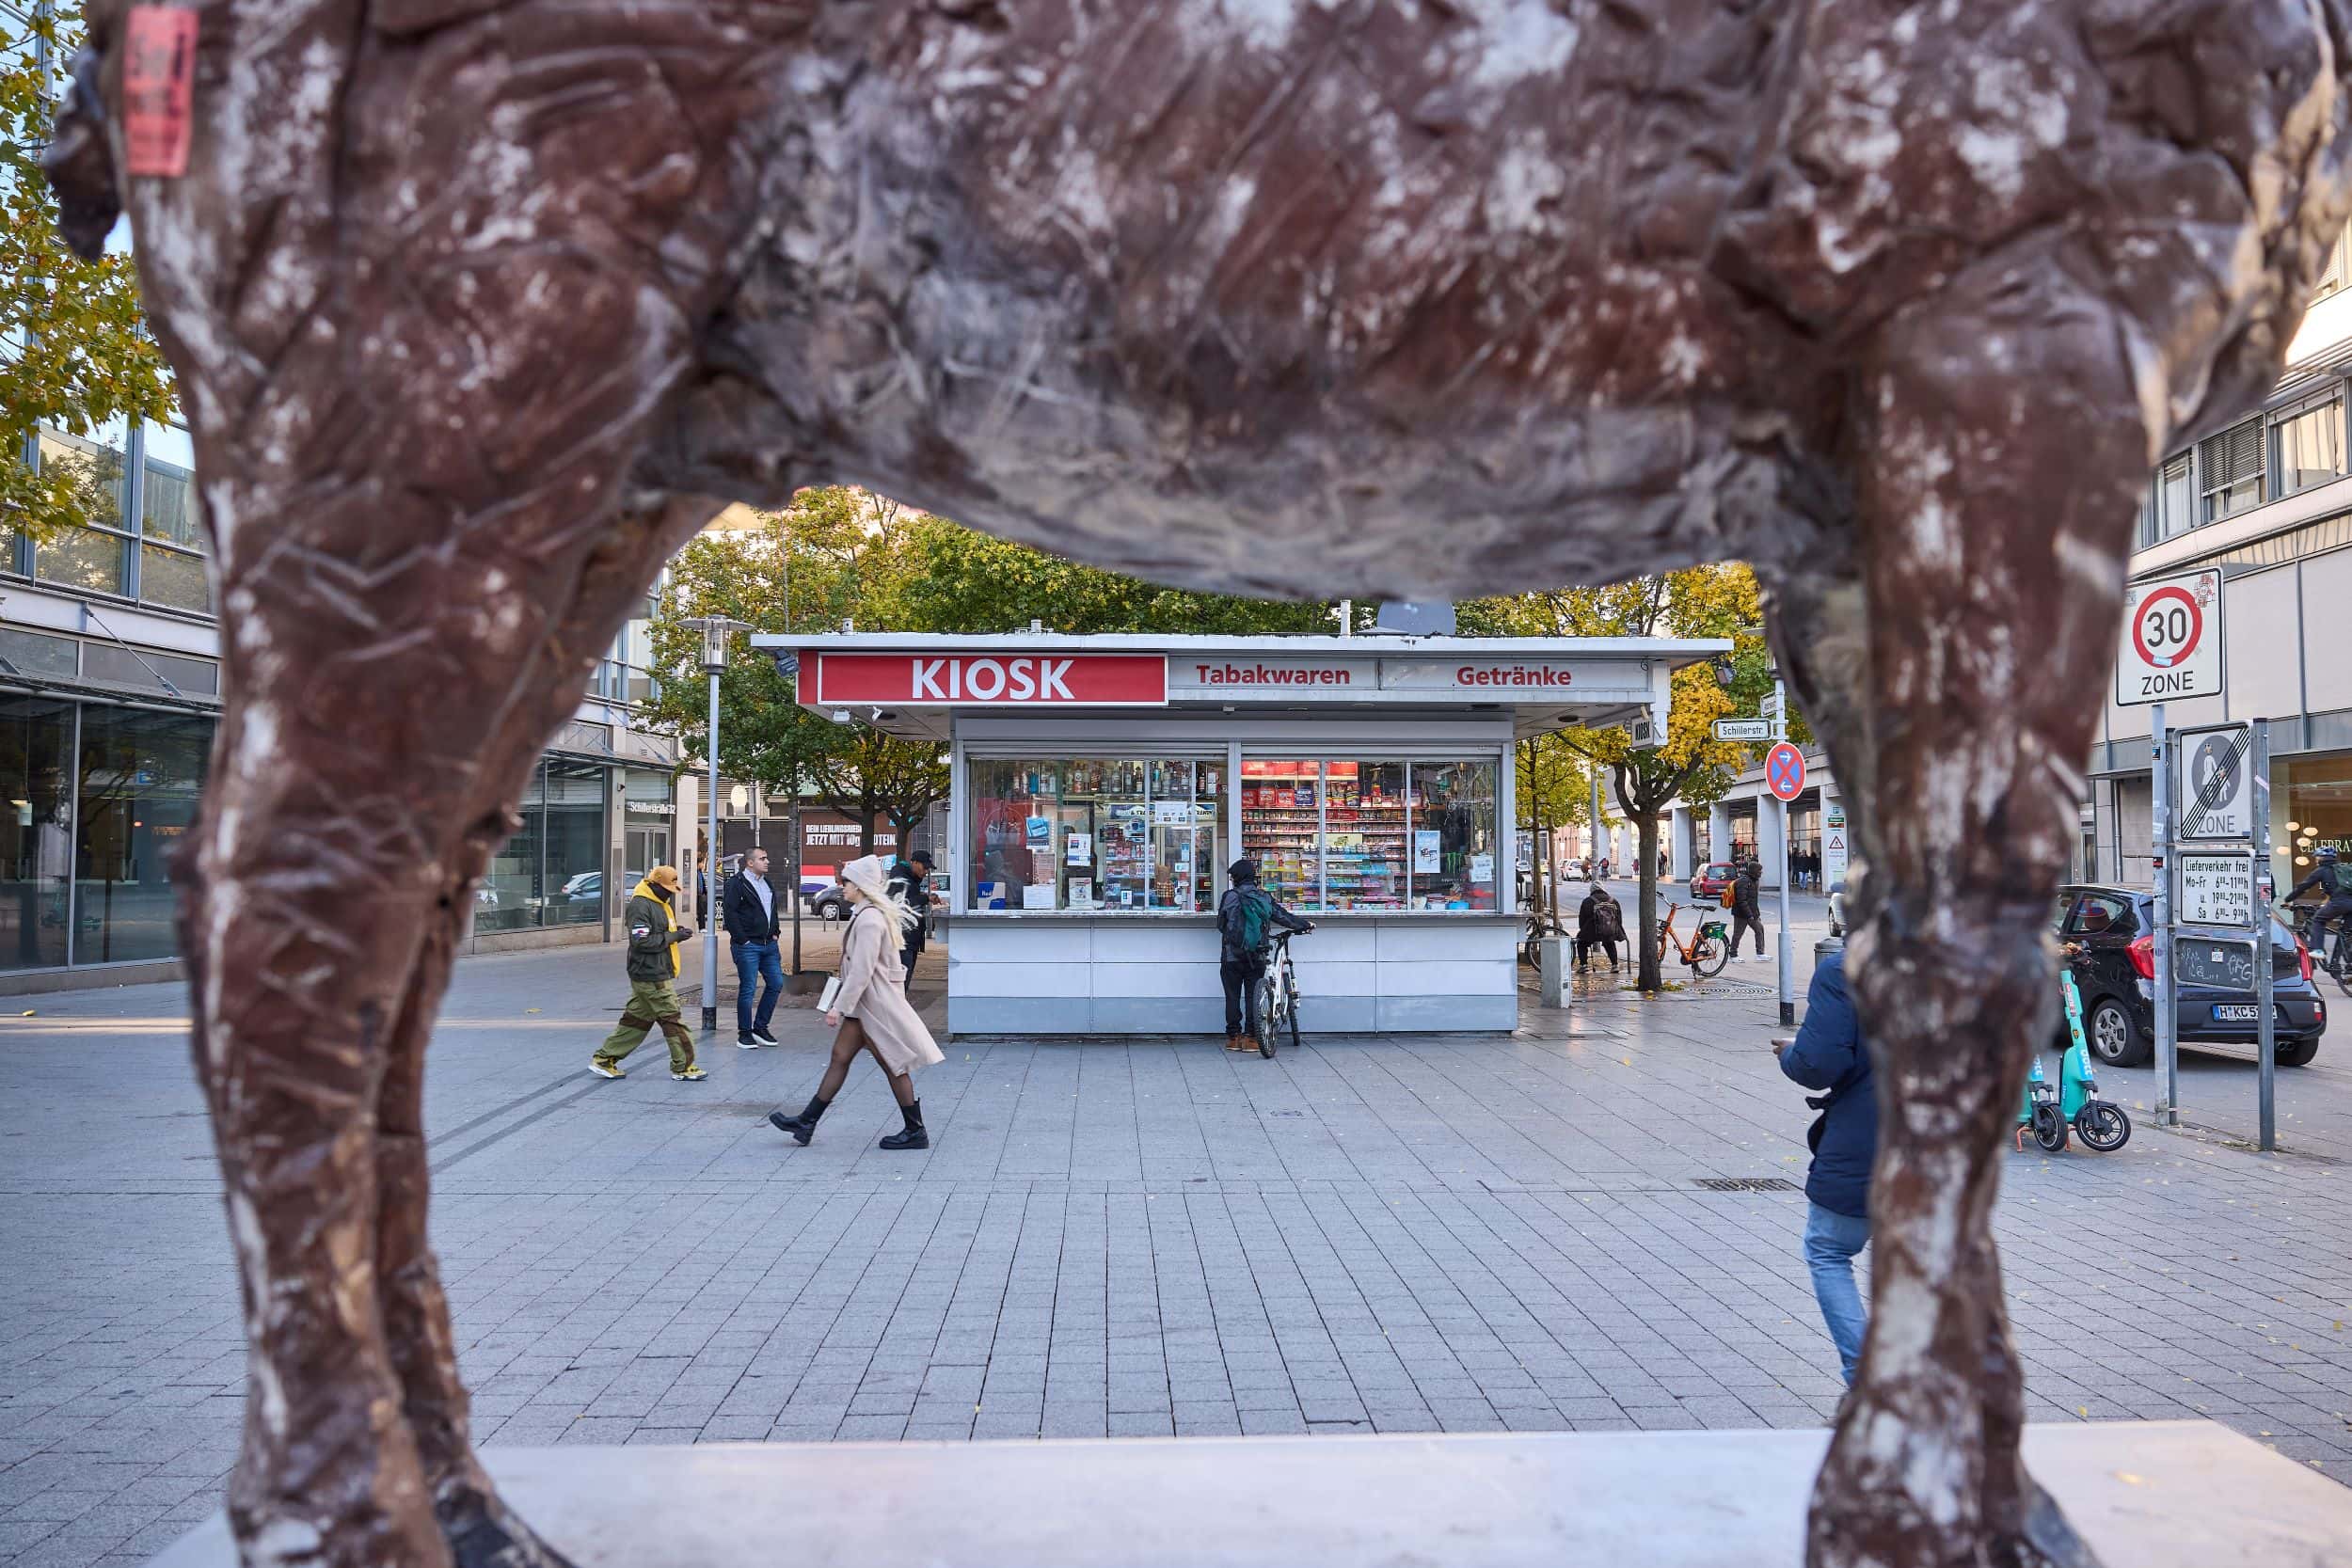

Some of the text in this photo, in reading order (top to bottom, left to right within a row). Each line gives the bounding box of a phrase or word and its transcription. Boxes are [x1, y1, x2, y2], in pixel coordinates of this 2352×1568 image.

[2147, 608, 2187, 647] 30
[913, 658, 1075, 700] KIOSK
[1196, 664, 1350, 684] Tabakwaren
[1457, 666, 1572, 686] Getränke
[2141, 671, 2194, 695] ZONE
[1635, 721, 1650, 740] KIOSK
[806, 824, 819, 833] DEIN
[2198, 815, 2235, 833] ZONE
[806, 834, 897, 847] JETZT MIT 10g OTEIN.
[2185, 860, 2249, 873] Lieferverkehr frei
[2185, 876, 2206, 888] Mo-Fr
[2198, 907, 2206, 919] Sa
[2220, 1007, 2228, 1018] H
[2234, 1007, 2249, 1018] KC
